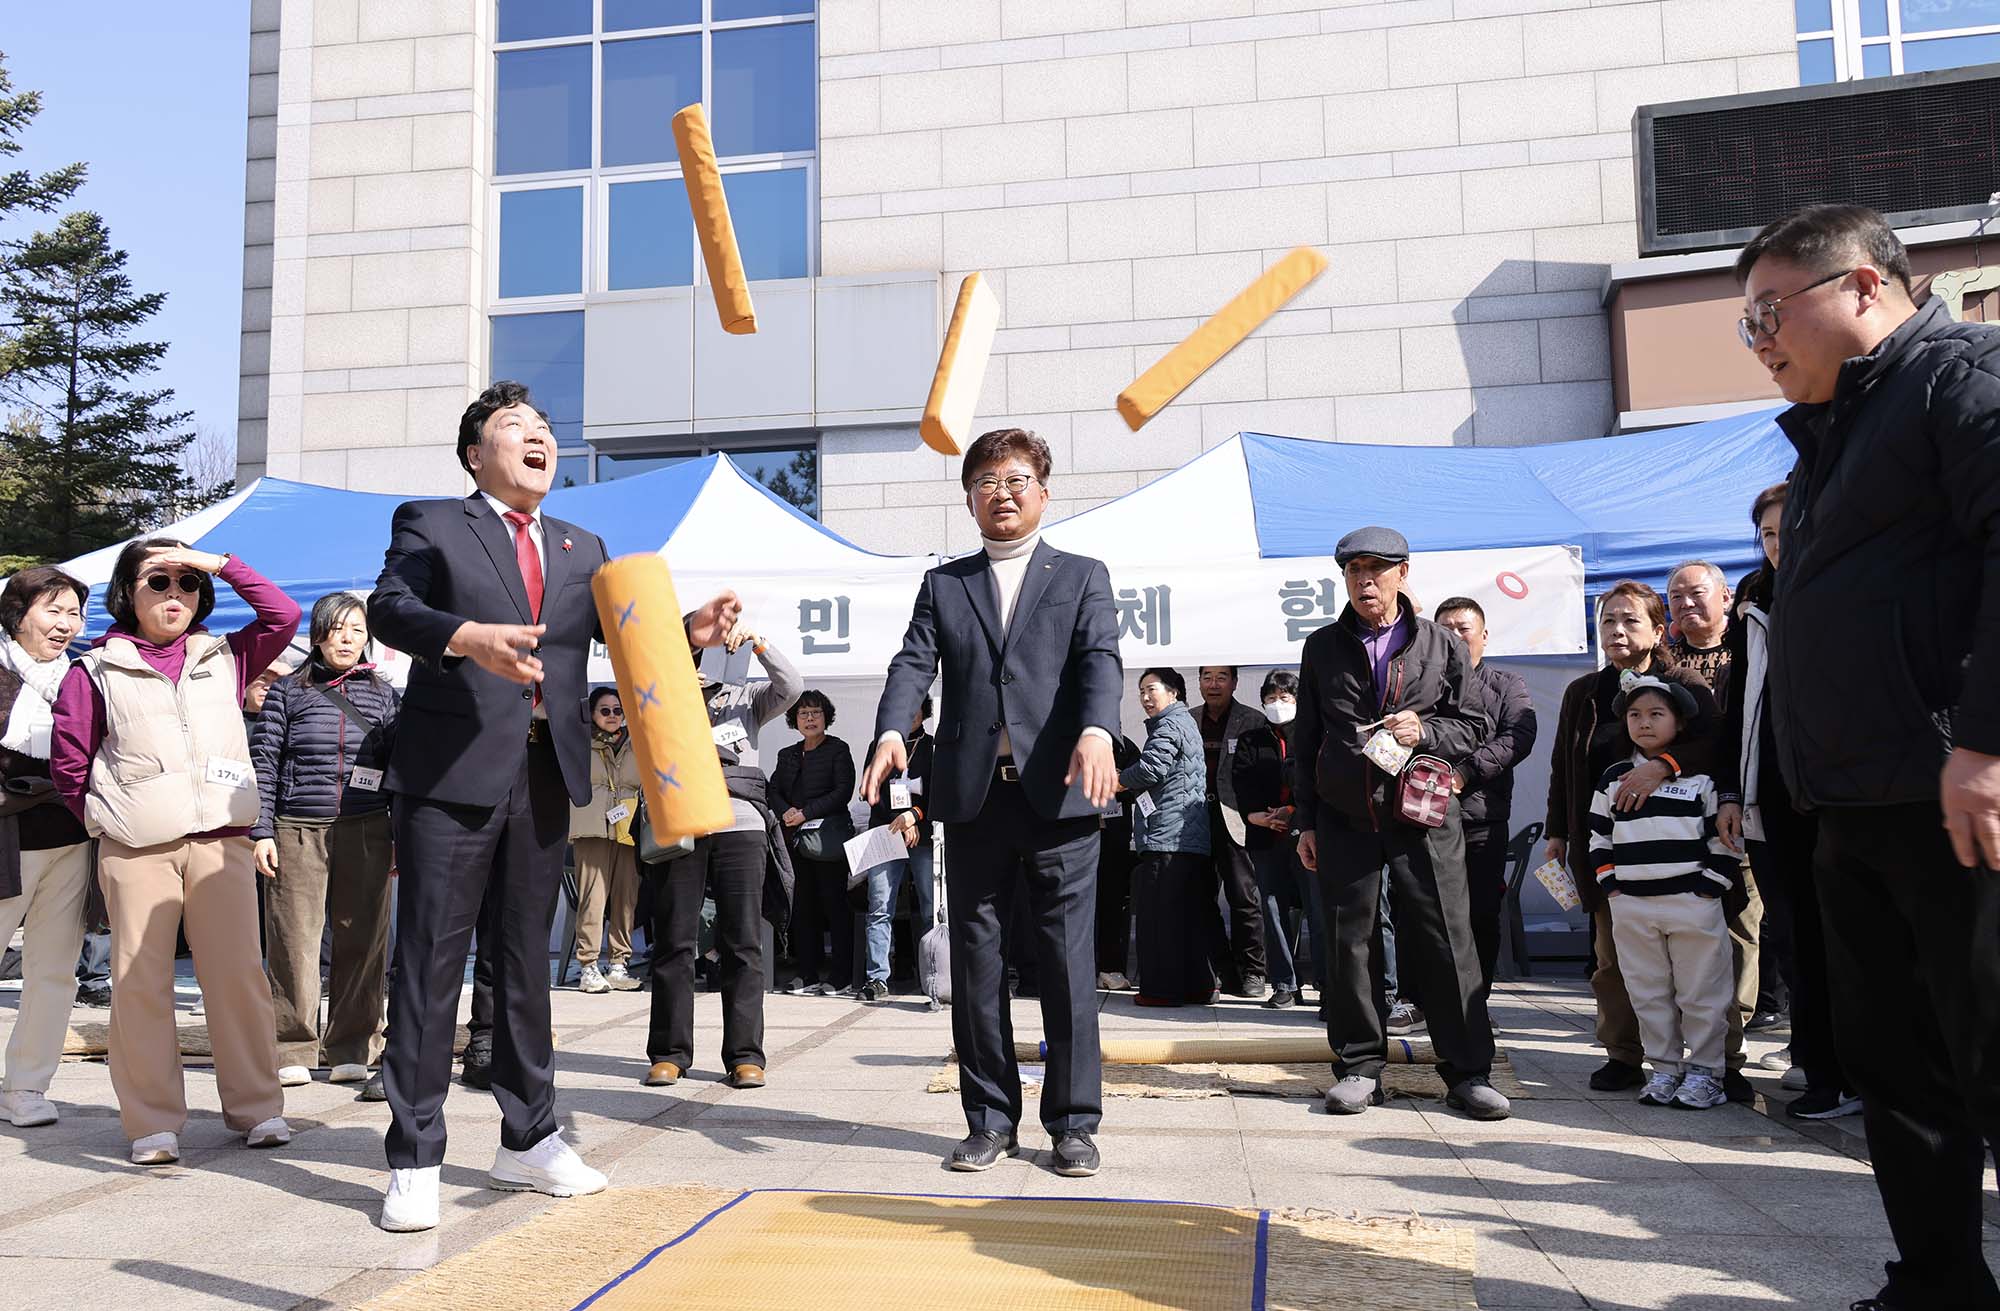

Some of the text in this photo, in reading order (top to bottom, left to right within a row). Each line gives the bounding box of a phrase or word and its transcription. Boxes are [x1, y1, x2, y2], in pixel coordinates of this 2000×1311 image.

[797, 577, 1336, 655] 민 체 험
